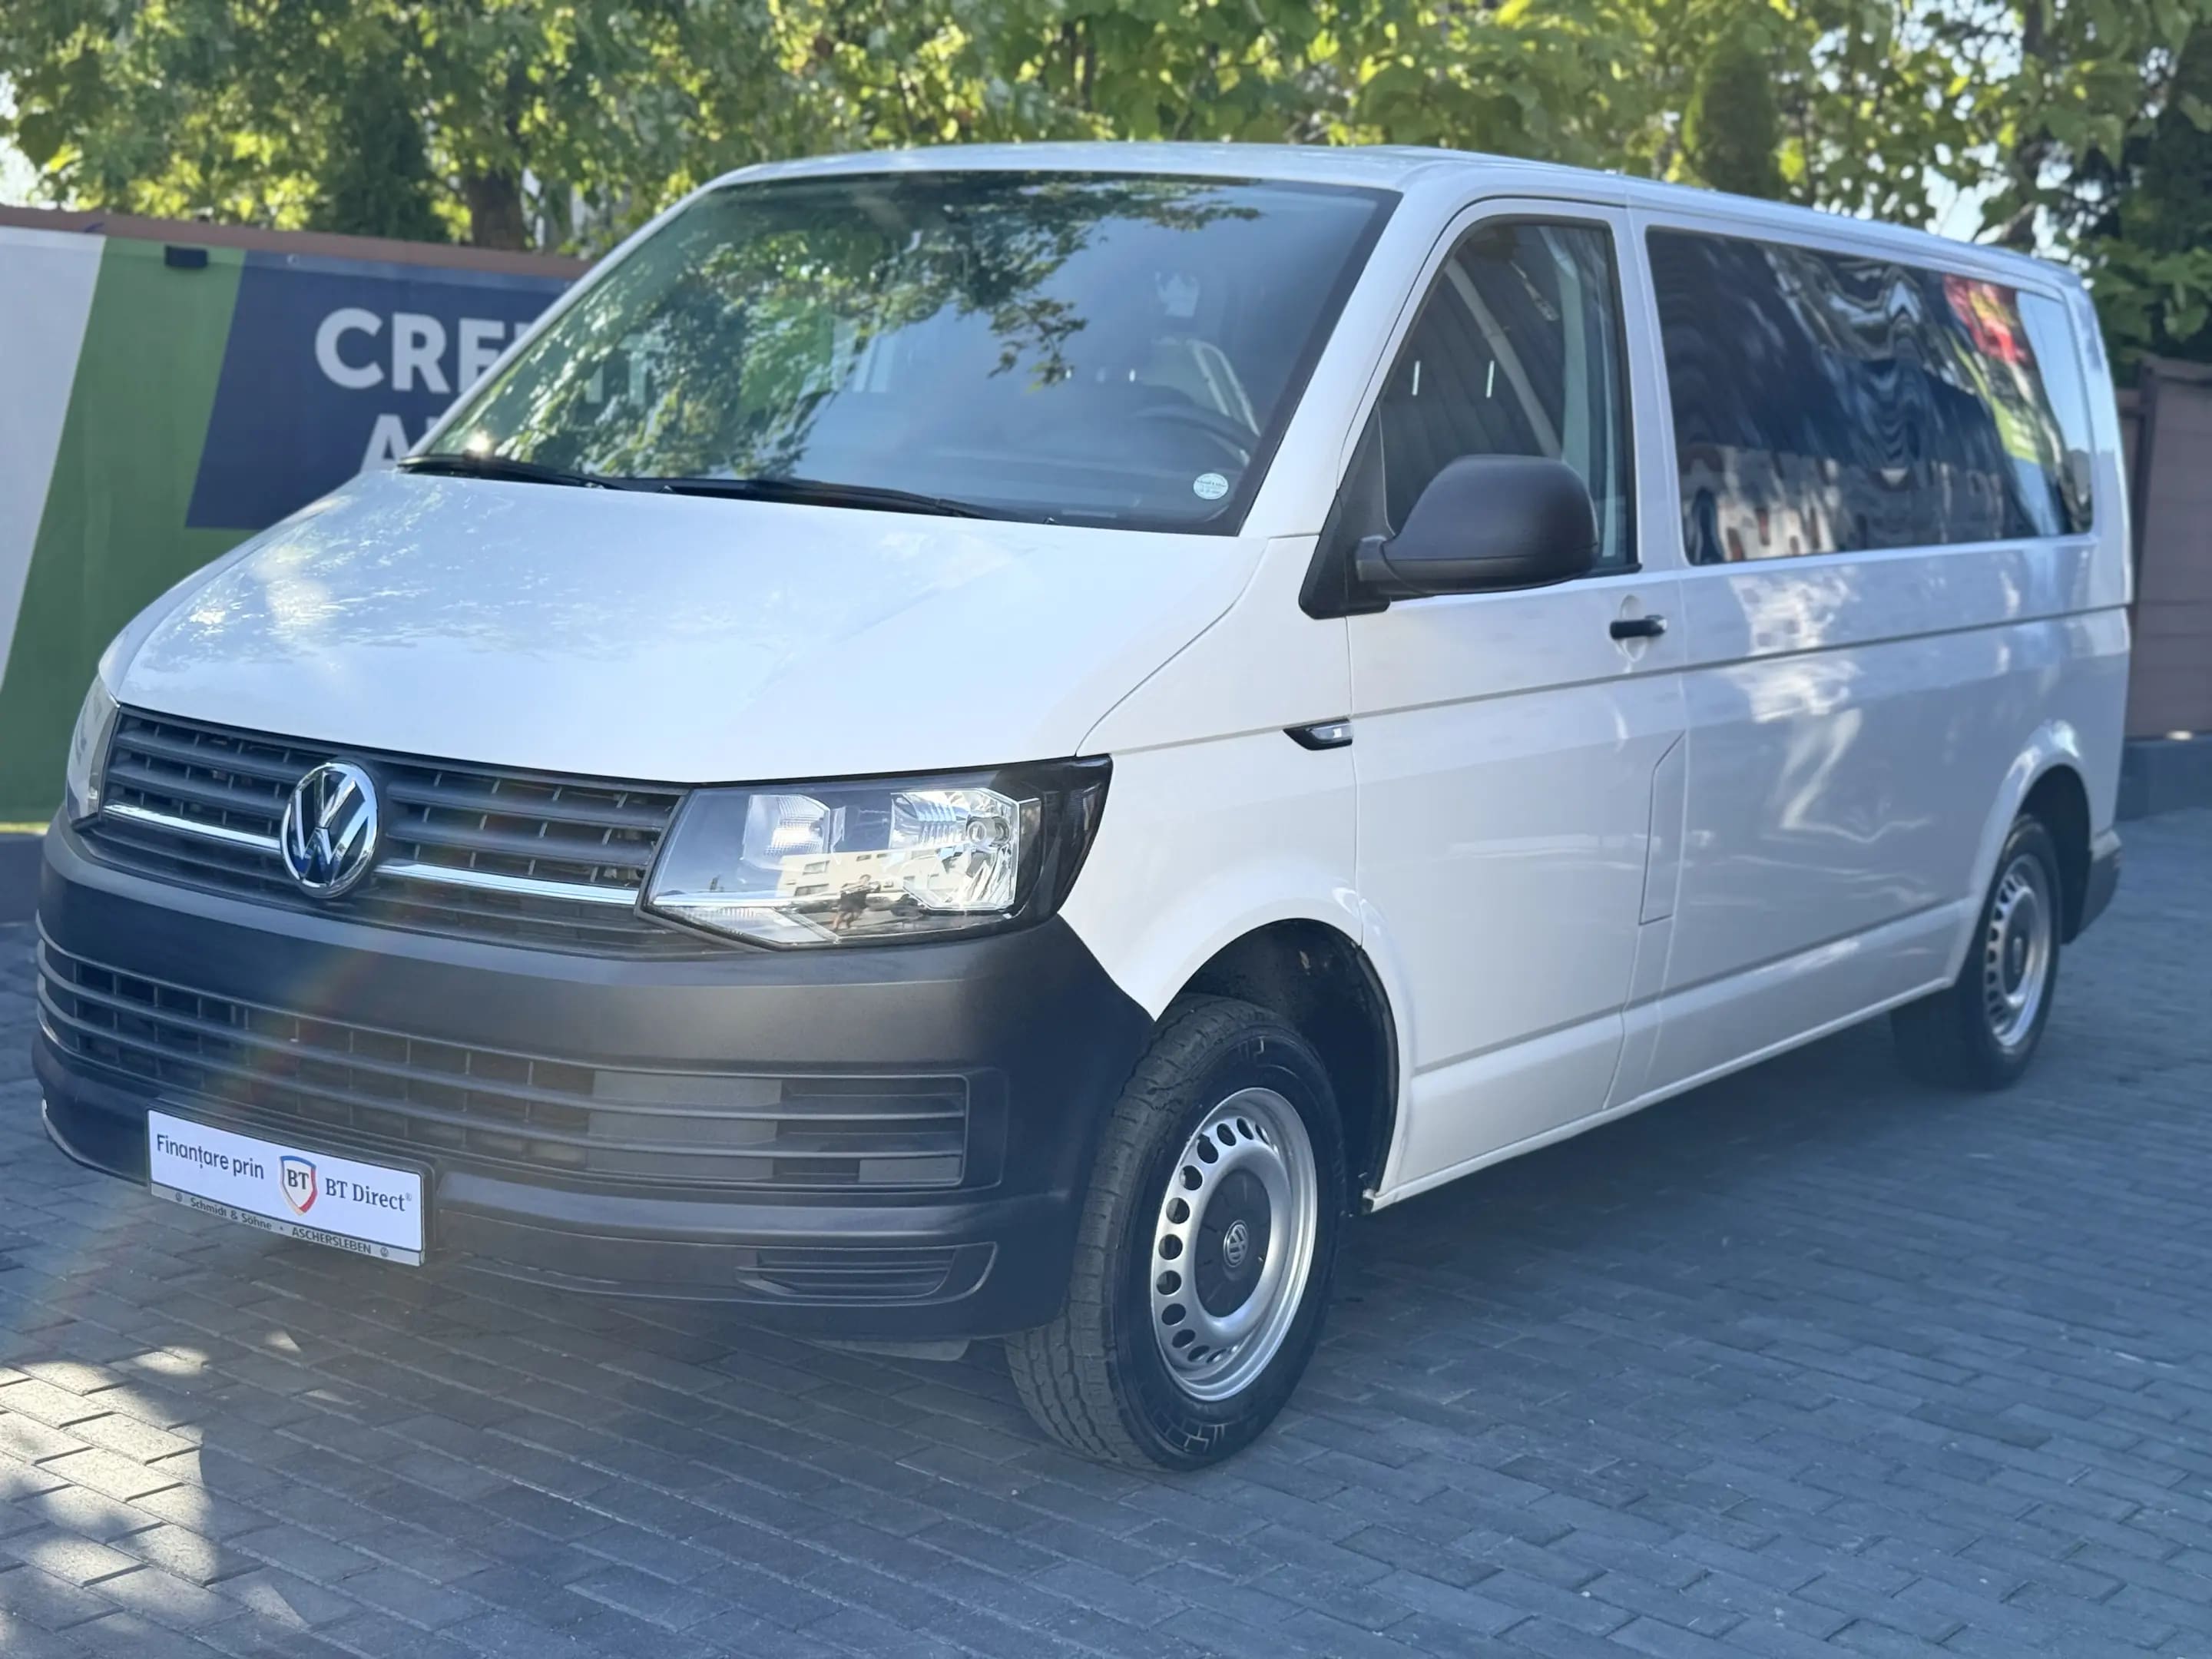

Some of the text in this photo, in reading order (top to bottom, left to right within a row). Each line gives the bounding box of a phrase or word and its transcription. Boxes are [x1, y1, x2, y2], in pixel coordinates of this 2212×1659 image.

[233, 1157, 264, 1180] prin
[286, 1168, 309, 1190] BT
[325, 1177, 348, 1199] BT
[190, 1197, 227, 1217] Schmidt
[230, 1210, 238, 1220] &
[241, 1213, 273, 1230] Söhne
[291, 1227, 372, 1254] ASCHERSLEBEN
